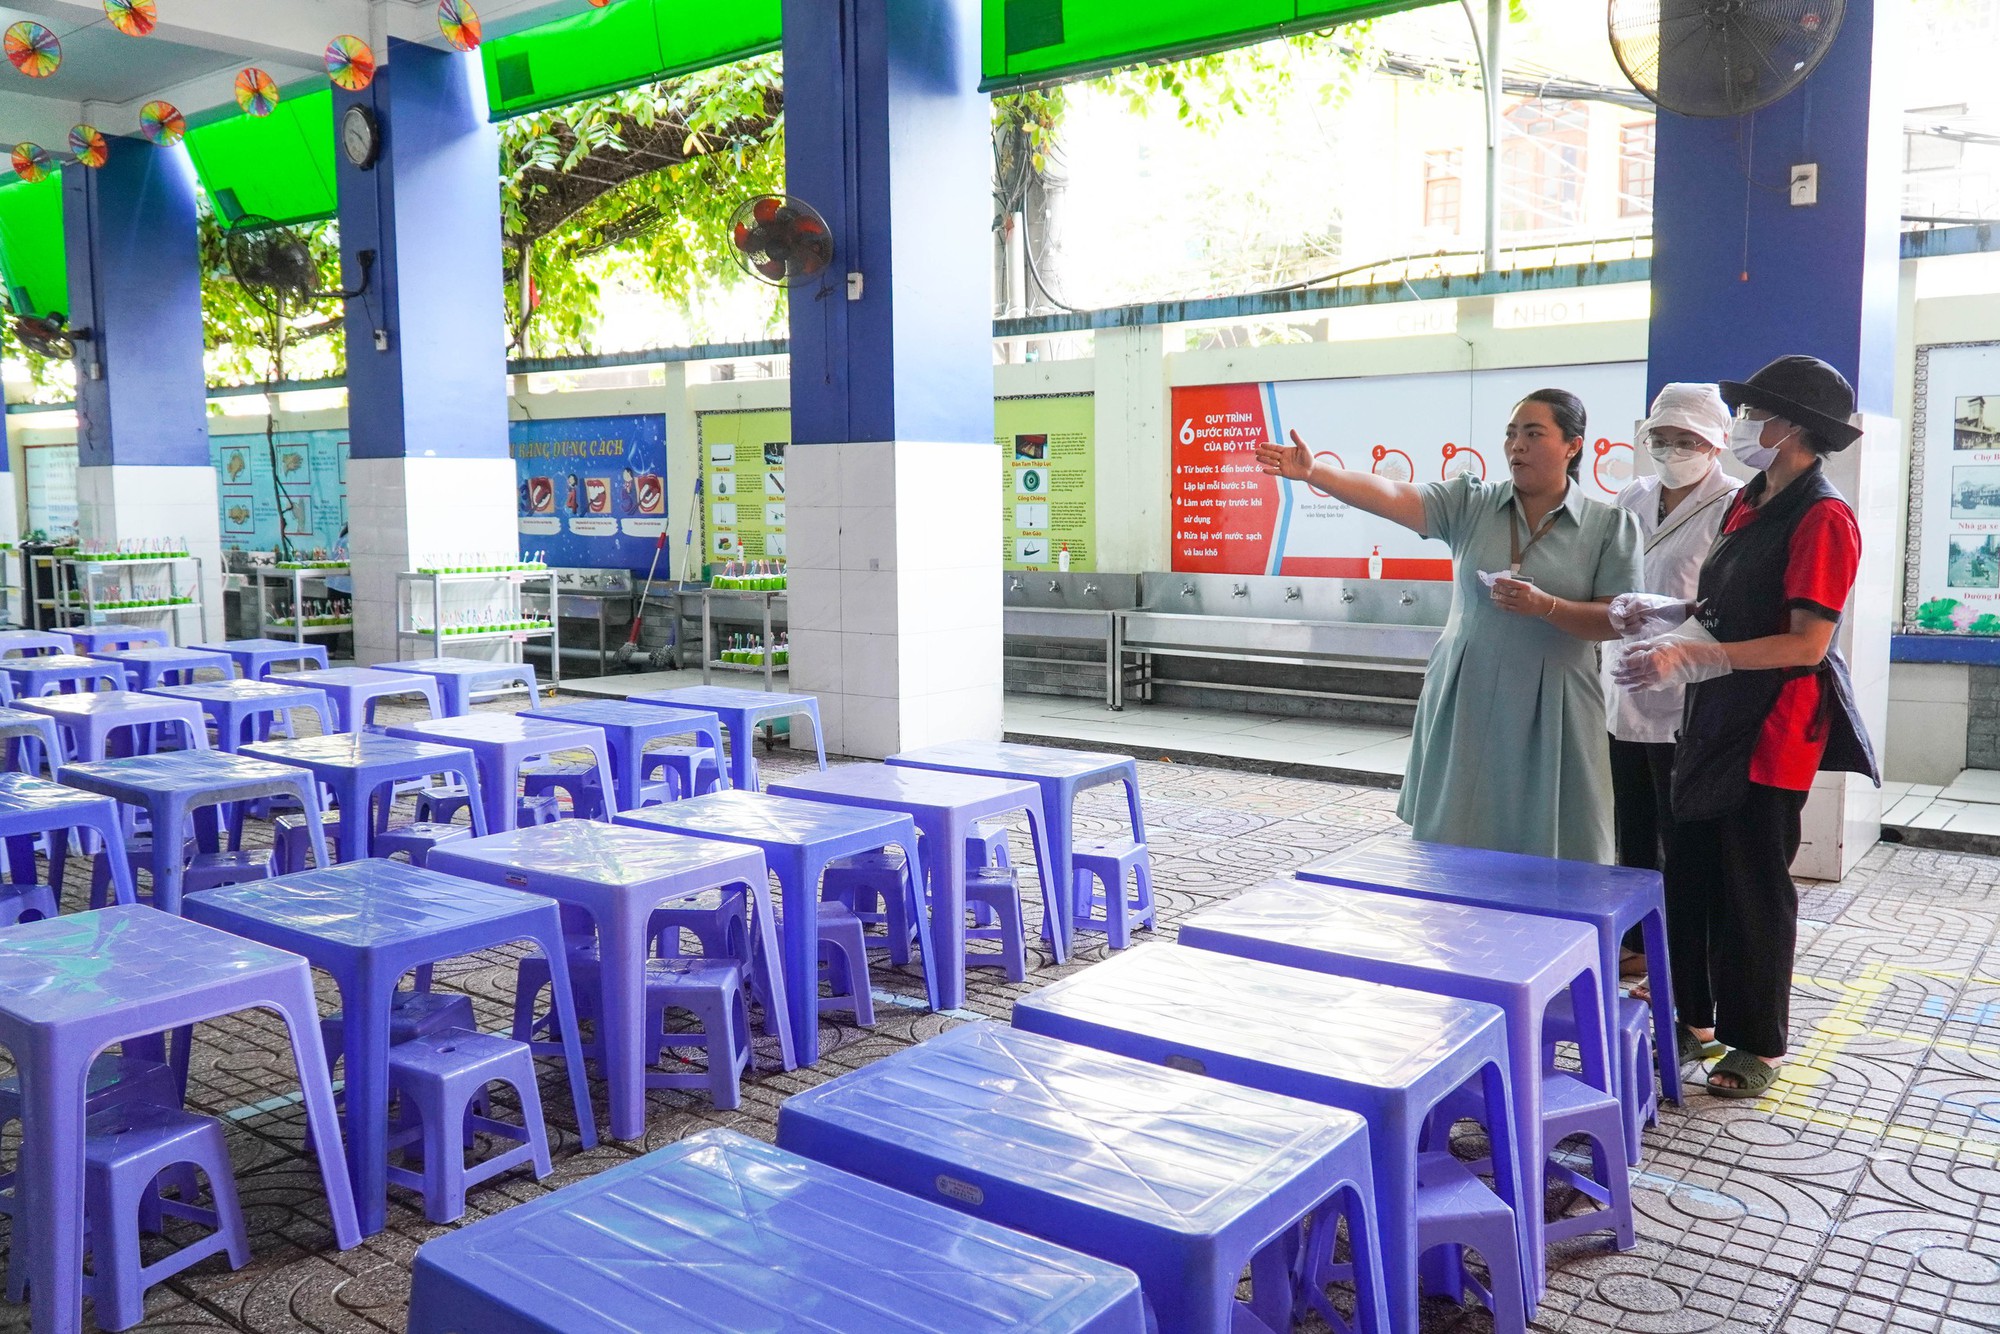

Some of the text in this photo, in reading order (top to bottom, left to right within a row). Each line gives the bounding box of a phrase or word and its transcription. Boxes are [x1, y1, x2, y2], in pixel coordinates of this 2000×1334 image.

[1205, 412, 1253, 425] QUY TRÌNH
[1179, 418, 1195, 445] 6
[1196, 426, 1262, 438] BƯỚC RỬA TAY
[1203, 439, 1257, 453] CỦA BỘ Y TẾ
[1446, 446, 1453, 455] 2
[1598, 441, 1606, 450] 4
[1377, 448, 1382, 457] 1
[1184, 465, 1194, 474] Từ
[1195, 465, 1213, 473] bước
[1214, 465, 1219, 473] 1
[1220, 465, 1234, 473] đến
[1235, 465, 1254, 473] bước
[1221, 481, 1240, 490] bước
[1241, 482, 1246, 490] 5
[1183, 498, 1198, 507] Làm
[1215, 498, 1227, 508] tay
[1229, 498, 1249, 507] trước
[1250, 498, 1263, 507] khi
[1194, 515, 1211, 525] dụng
[1211, 531, 1223, 540] với
[1225, 531, 1244, 540] nước
[1246, 531, 1262, 541] sạch
[1183, 548, 1192, 556] và
[1193, 548, 1204, 556] lau
